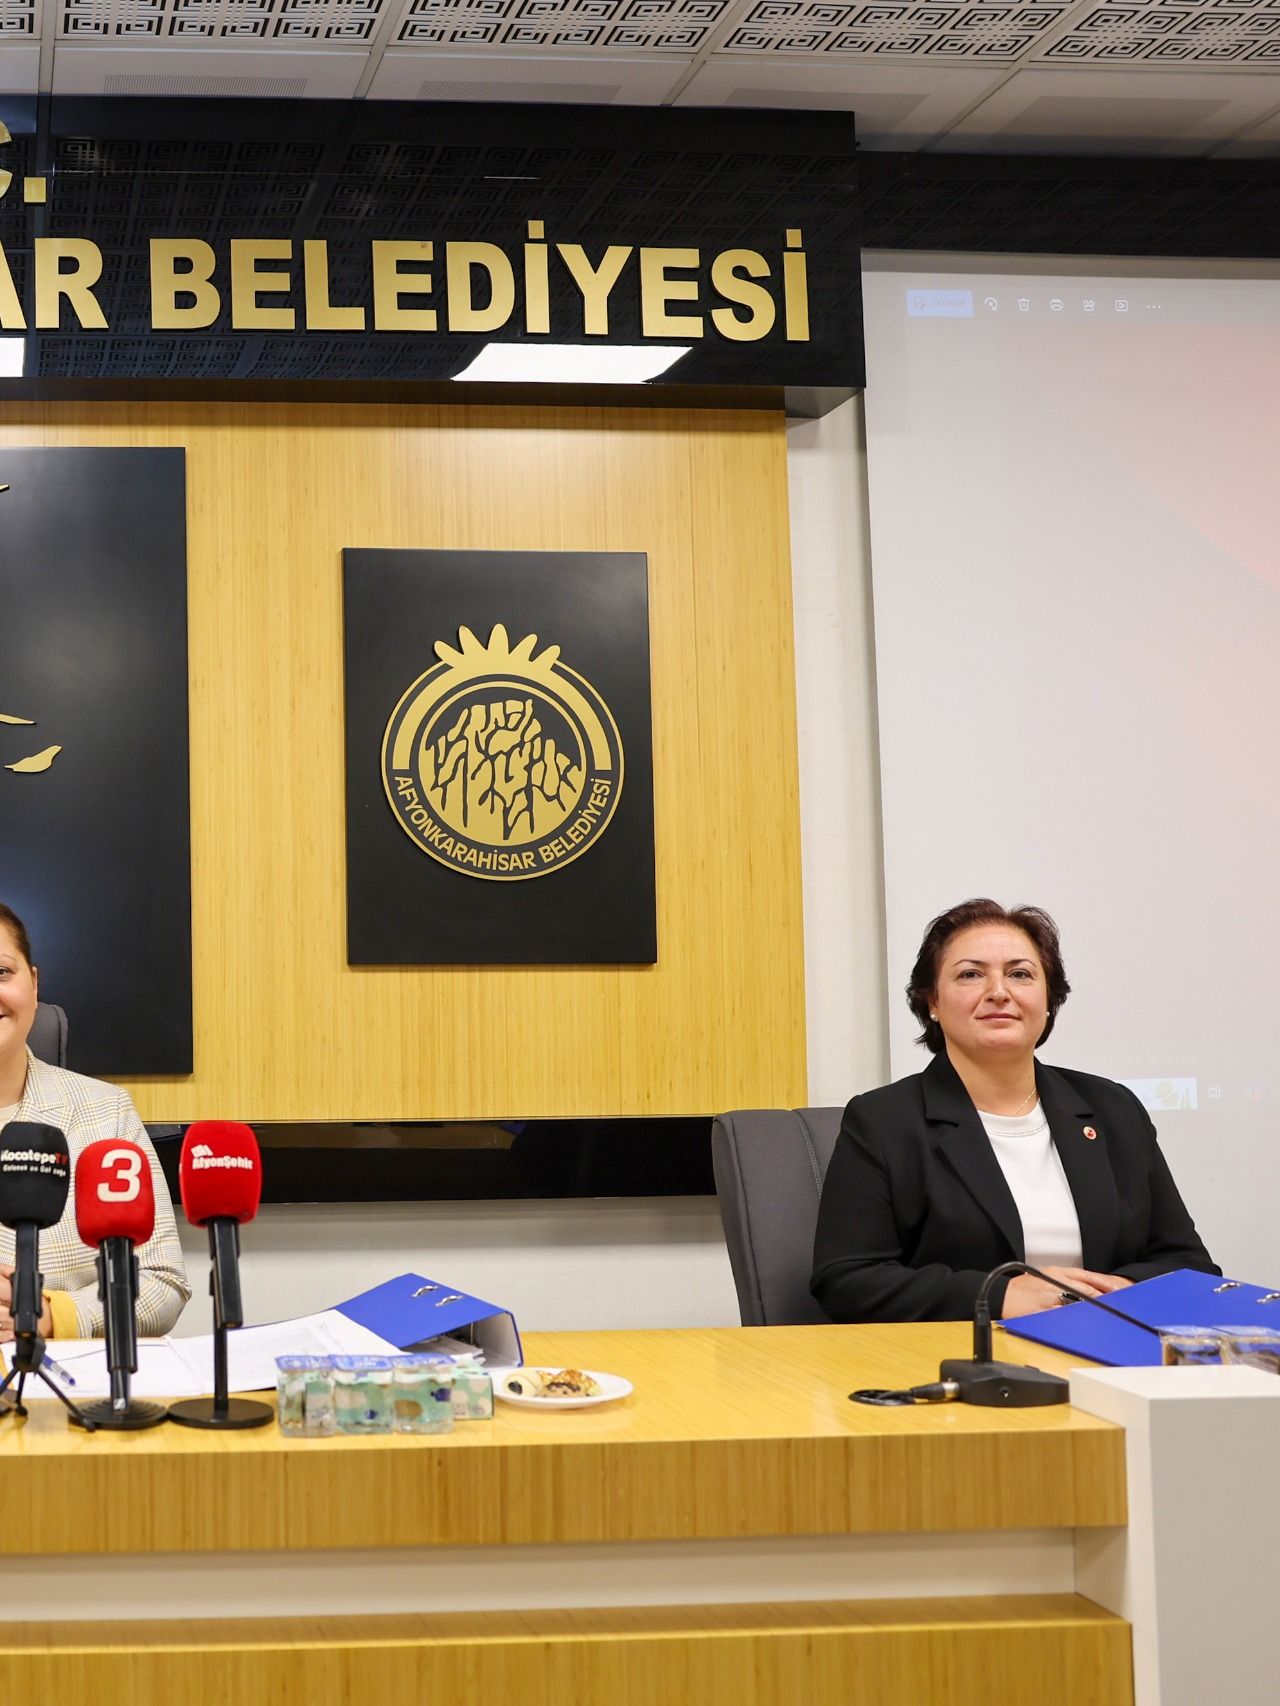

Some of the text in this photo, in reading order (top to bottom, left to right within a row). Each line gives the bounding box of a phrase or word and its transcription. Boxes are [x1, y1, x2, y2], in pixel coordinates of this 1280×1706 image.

[149, 220, 810, 342] BELEDİYESİ
[394, 775, 613, 871] AFYONKARAHİSAR BELEDİYESİ
[97, 1149, 142, 1203] 3
